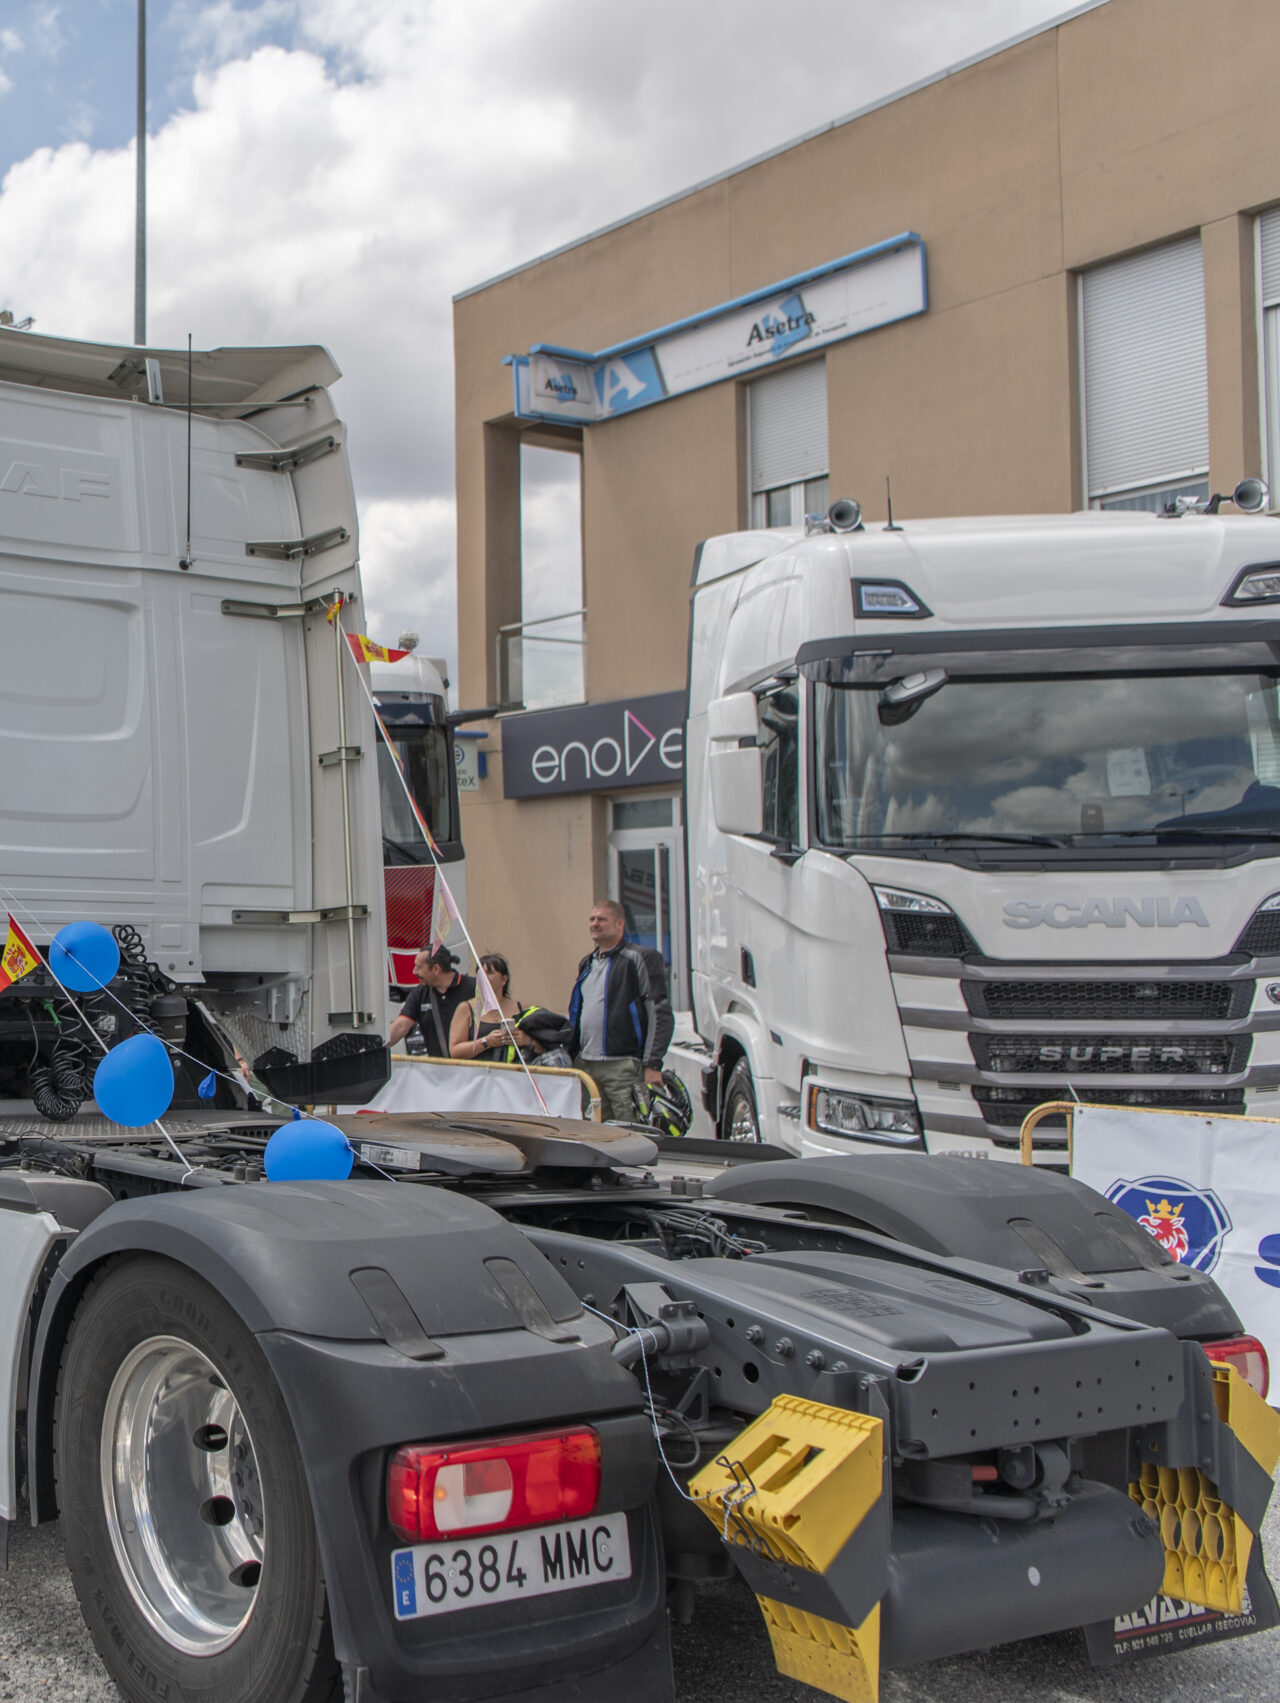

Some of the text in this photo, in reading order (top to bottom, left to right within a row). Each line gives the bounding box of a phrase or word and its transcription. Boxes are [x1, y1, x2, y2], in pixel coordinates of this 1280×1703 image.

[746, 311, 817, 347] Asetra
[1002, 897, 1209, 928] SCANIA
[1038, 1045, 1185, 1062] SUPER
[423, 1525, 615, 1603] 6384 MMC
[1178, 1623, 1213, 1640] CUELLAR
